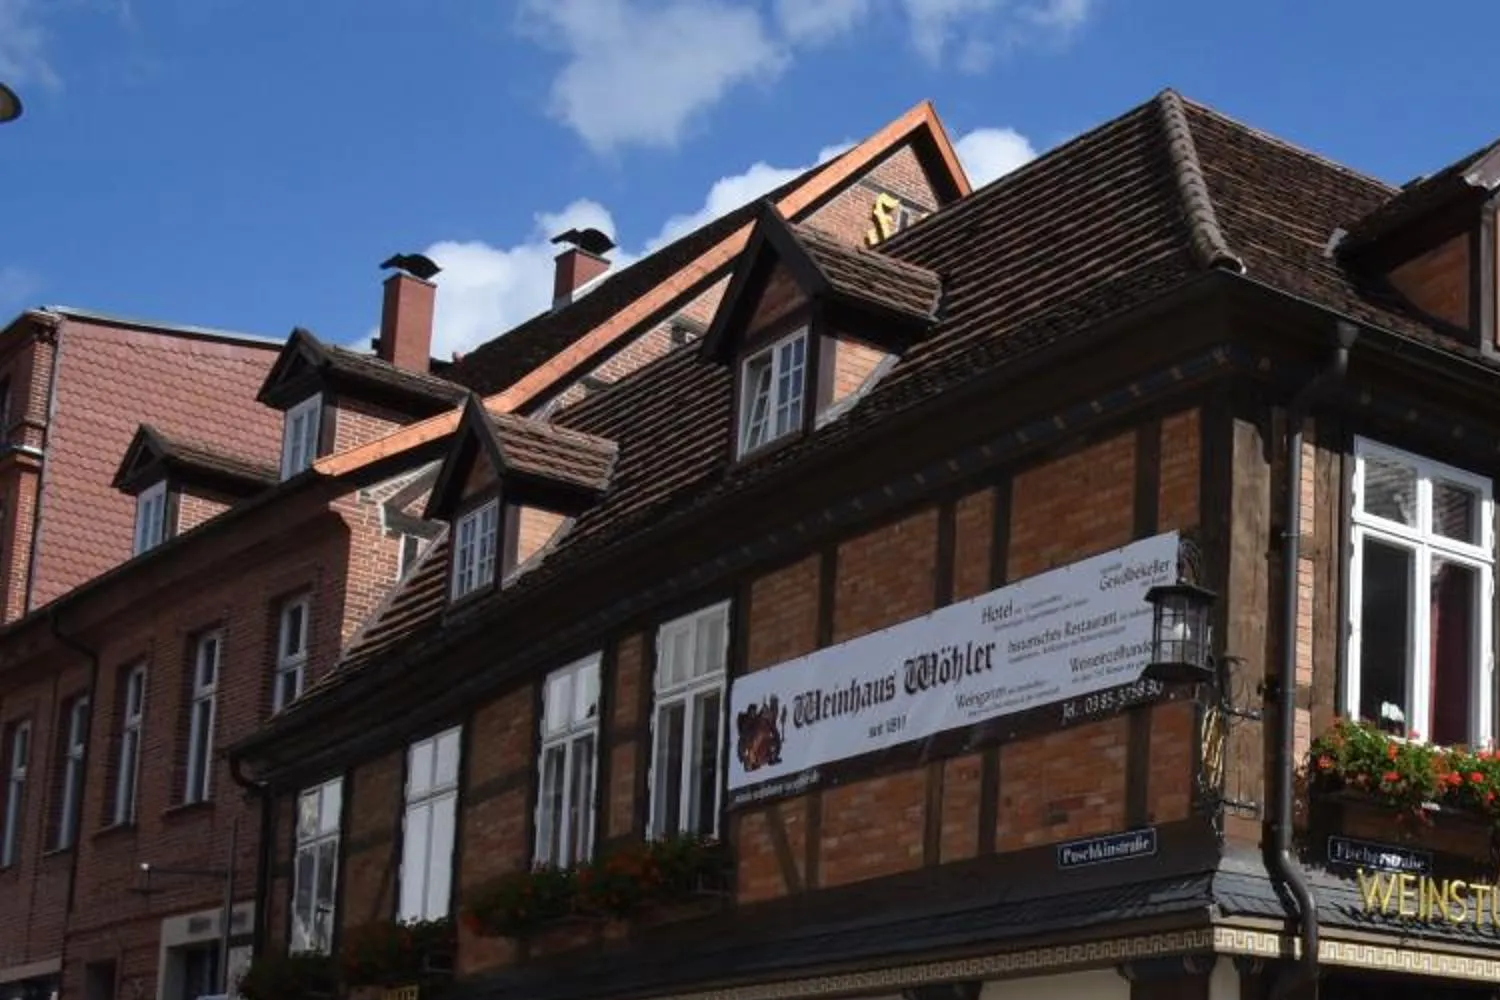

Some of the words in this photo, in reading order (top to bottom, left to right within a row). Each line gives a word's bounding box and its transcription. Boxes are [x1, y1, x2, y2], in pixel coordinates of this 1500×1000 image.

[982, 600, 1014, 624] Hotel
[1064, 612, 1117, 636] Restaurant
[793, 670, 897, 728] Weinhaus
[903, 641, 996, 695] Wöhler
[1063, 834, 1149, 864] Puschkinstraße
